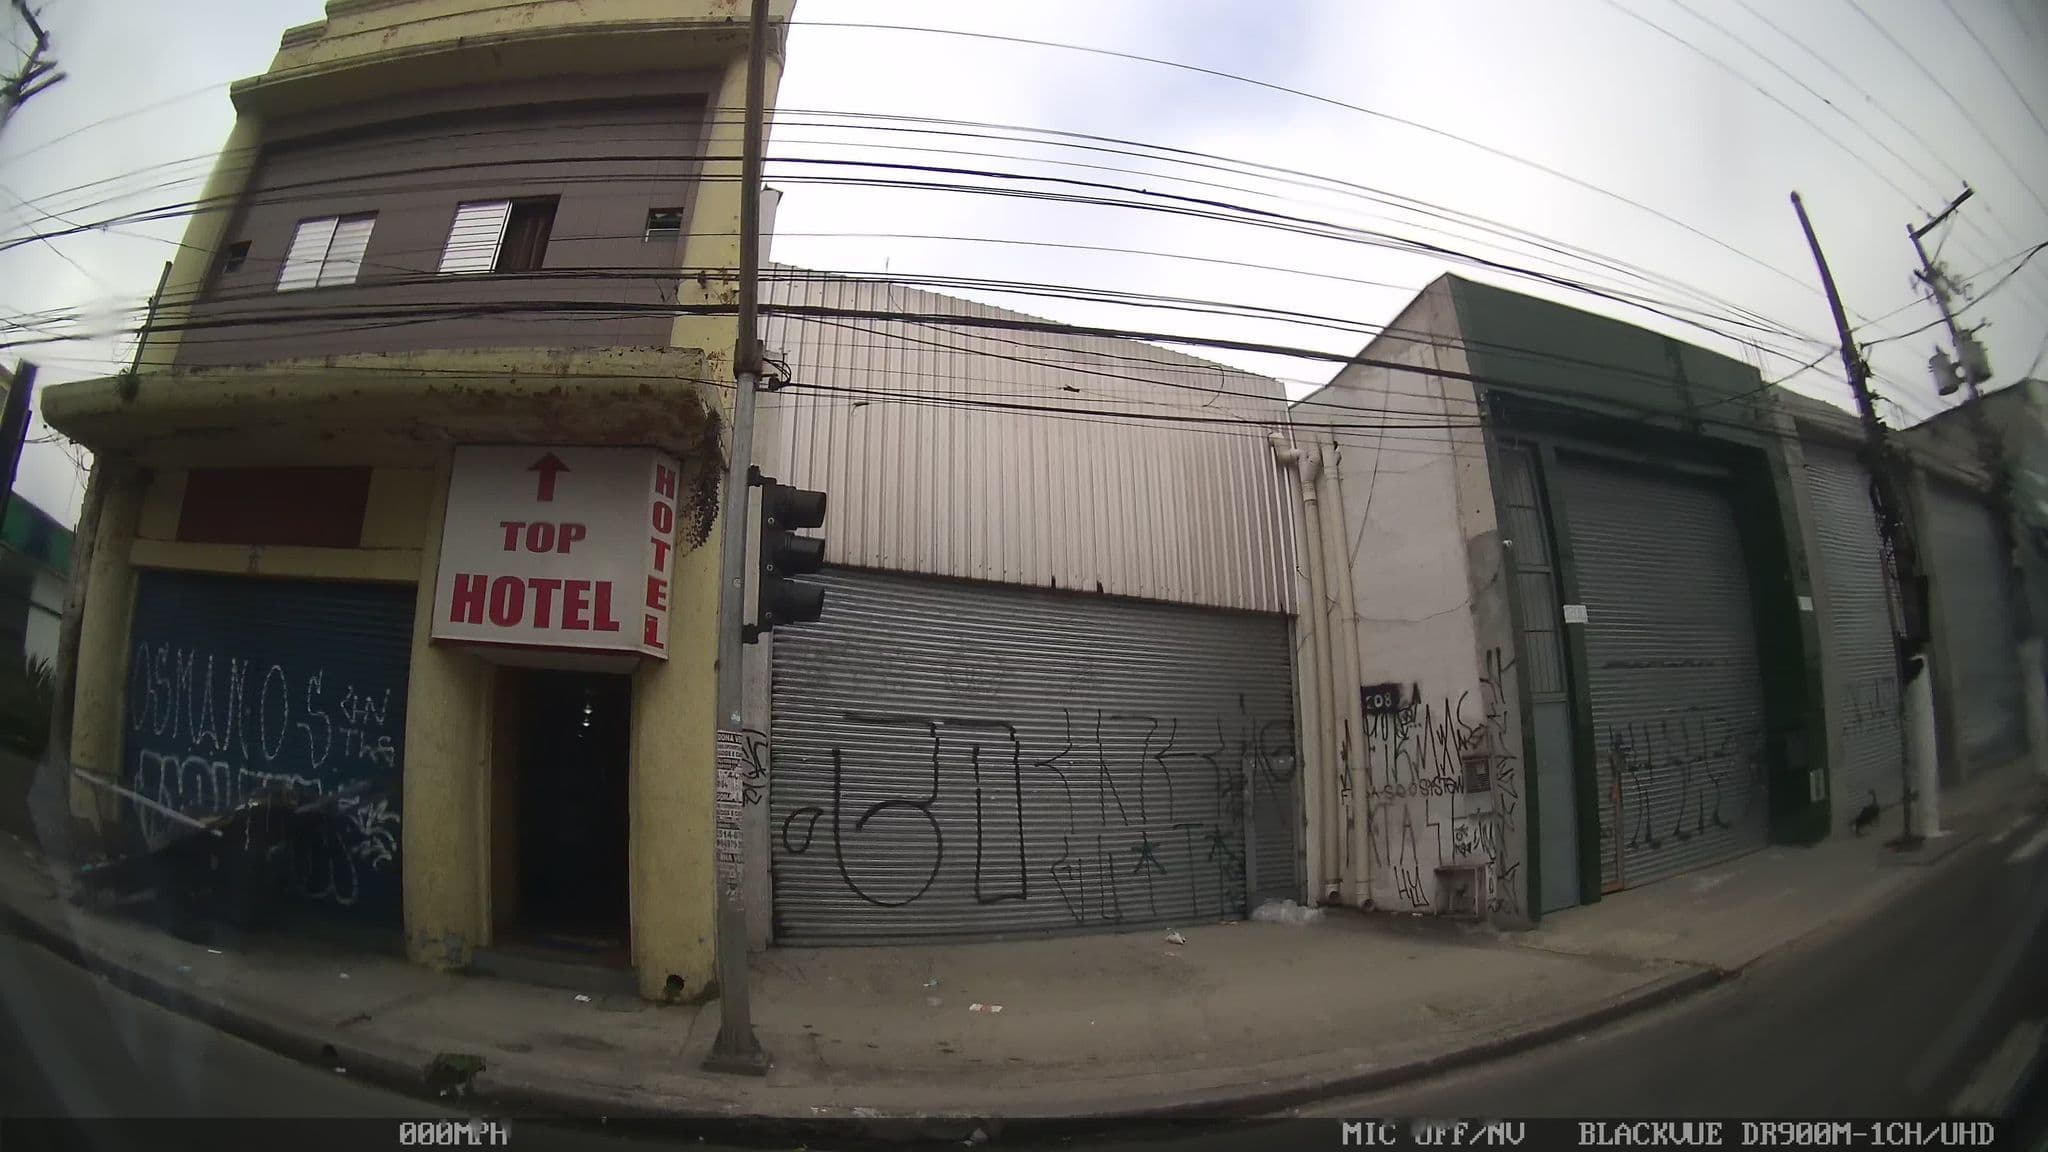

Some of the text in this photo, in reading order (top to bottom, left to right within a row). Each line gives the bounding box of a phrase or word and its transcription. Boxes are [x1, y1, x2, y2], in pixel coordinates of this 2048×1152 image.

[500, 521, 587, 554] TOP
[644, 464, 676, 650] HOTEL
[450, 573, 620, 632] HOTEL
